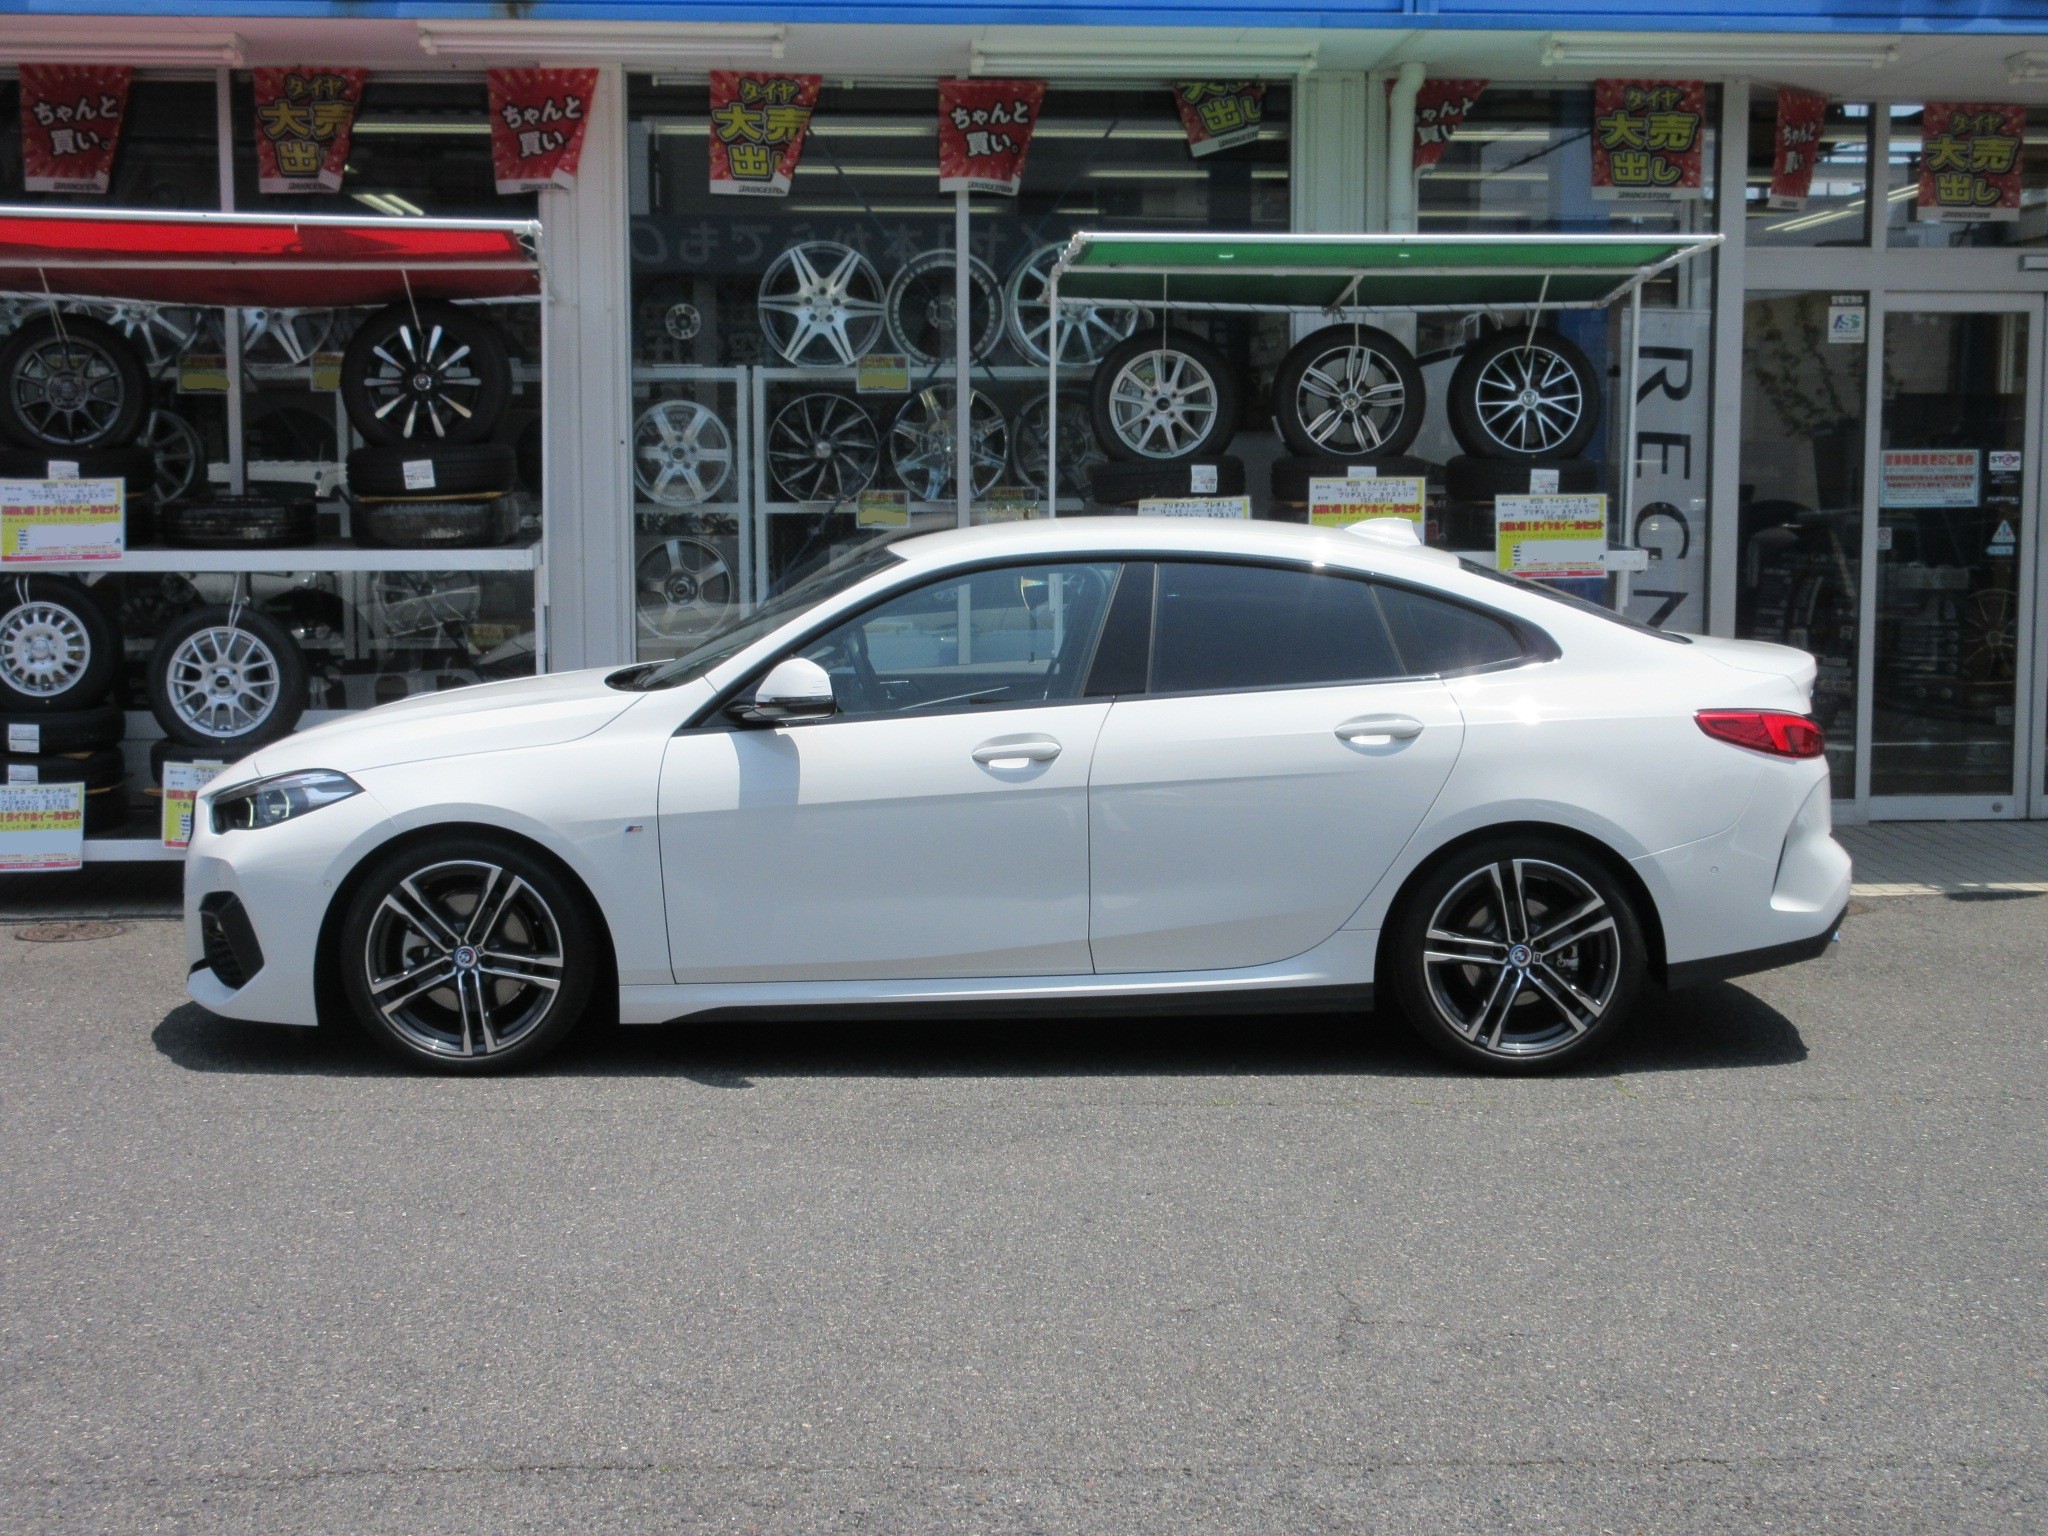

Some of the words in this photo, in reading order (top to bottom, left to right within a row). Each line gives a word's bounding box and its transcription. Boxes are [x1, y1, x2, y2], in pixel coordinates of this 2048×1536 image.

[288, 78, 342, 96] タイヤ
[743, 81, 797, 101] タイヤ
[1626, 88, 1680, 108] タイヤ
[33, 96, 118, 125] ちゃんと
[502, 96, 582, 129] ちゃんと
[712, 103, 811, 141] 大売
[950, 101, 1029, 130] ちゃんと
[1199, 96, 1261, 133] 出し
[1952, 115, 2002, 133] タイヤ
[50, 129, 110, 155] 買い。
[966, 131, 1019, 157] 買い。
[1599, 112, 1697, 148] 大売
[1611, 151, 1680, 183] 出し
[1925, 136, 2017, 170] 大売
[1937, 174, 2001, 203] 出し
